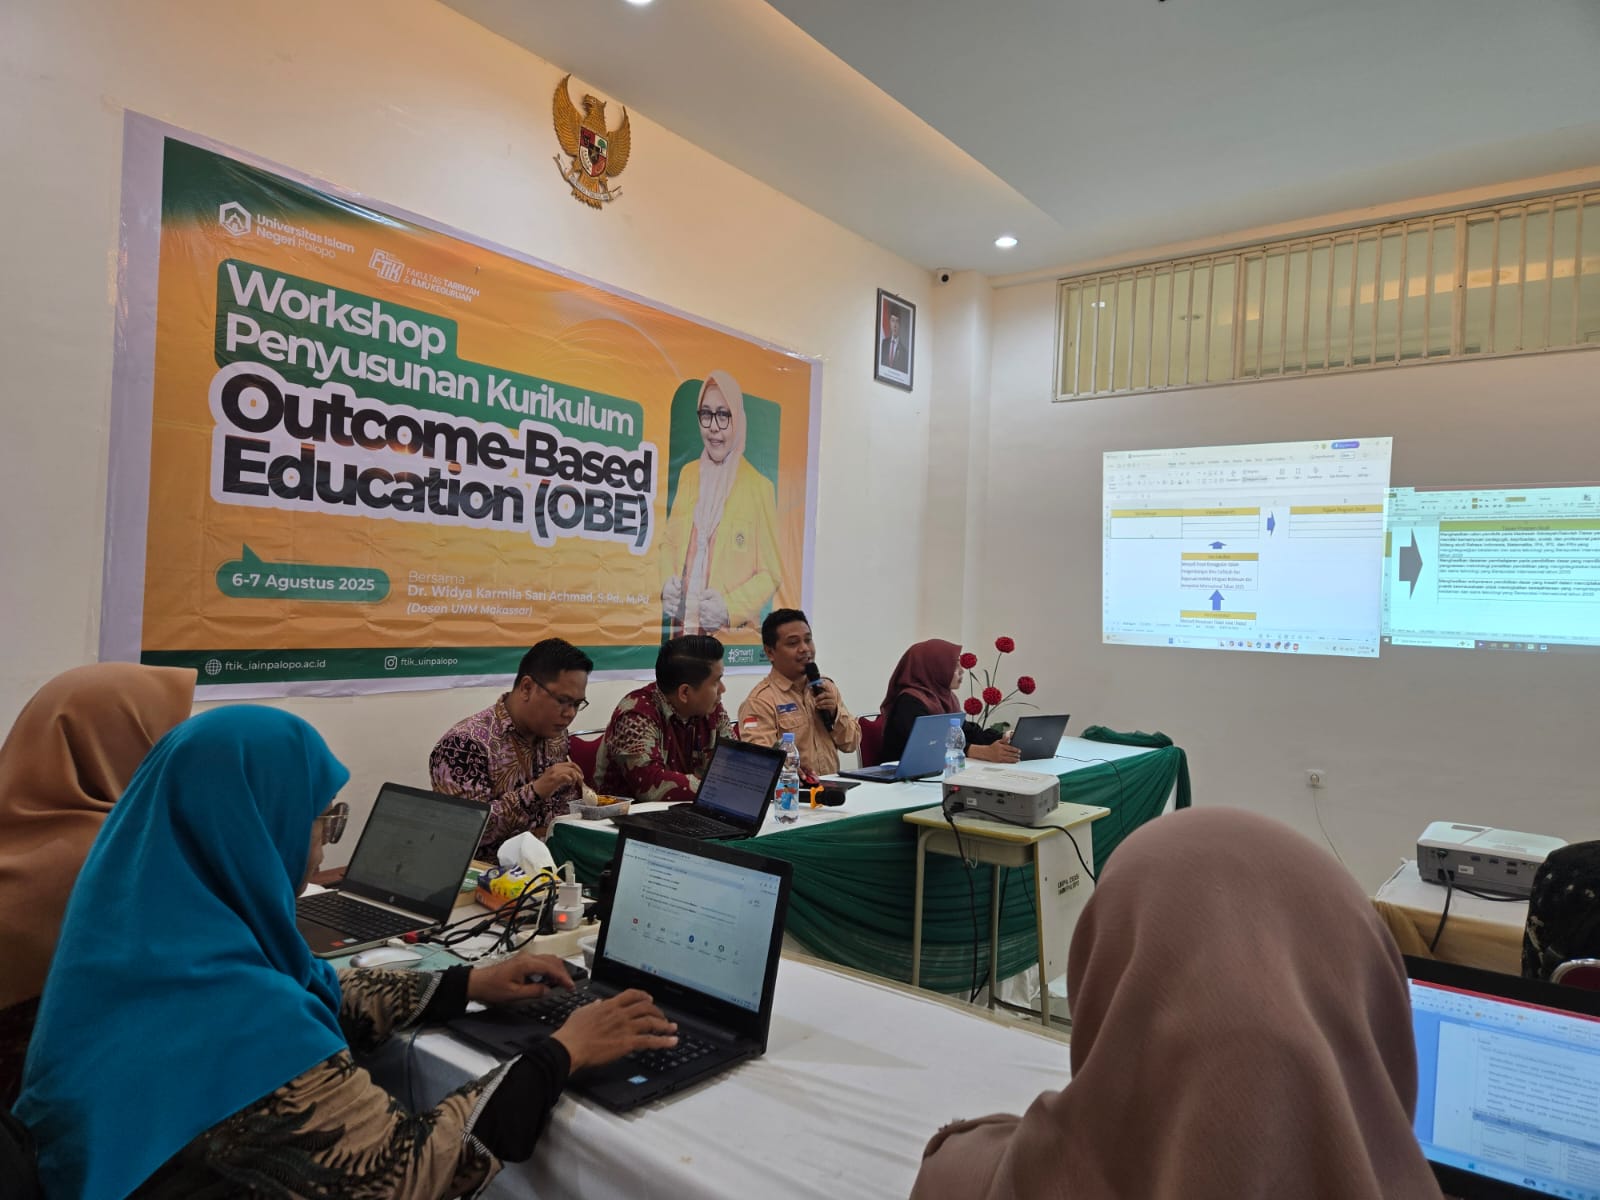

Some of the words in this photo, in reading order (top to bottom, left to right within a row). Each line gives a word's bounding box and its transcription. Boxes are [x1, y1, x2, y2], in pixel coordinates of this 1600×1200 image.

[256, 225, 296, 247] Negeri
[298, 238, 336, 259] Palopo
[257, 213, 322, 244] Universitas
[324, 235, 355, 254] Islam
[406, 267, 443, 285] FAKULTAS
[443, 279, 480, 297] TARBIYAH
[410, 277, 431, 290] ILMU
[430, 283, 473, 303] KEGURUAN
[226, 263, 447, 360] Workshop
[226, 312, 480, 402] Penyusunan
[487, 374, 635, 436] Kurikulum
[221, 372, 653, 493] Outcome-Based
[222, 434, 525, 523] Education
[535, 478, 650, 548] (OBE)
[232, 572, 260, 588] 6-7
[265, 574, 335, 592] Agustus
[338, 577, 376, 592] 2025
[408, 570, 465, 585] Bersama
[407, 584, 428, 597] Dr.
[431, 586, 473, 600] Widya
[476, 587, 522, 601] Karmila
[524, 589, 547, 601] Sari
[406, 602, 448, 616] (Dosen
[451, 603, 478, 615] UNM
[480, 605, 533, 618] Makassar)
[224, 659, 327, 672] ftik_iainpalopo.ac.id
[400, 657, 458, 667] ftik_uinpalopo
